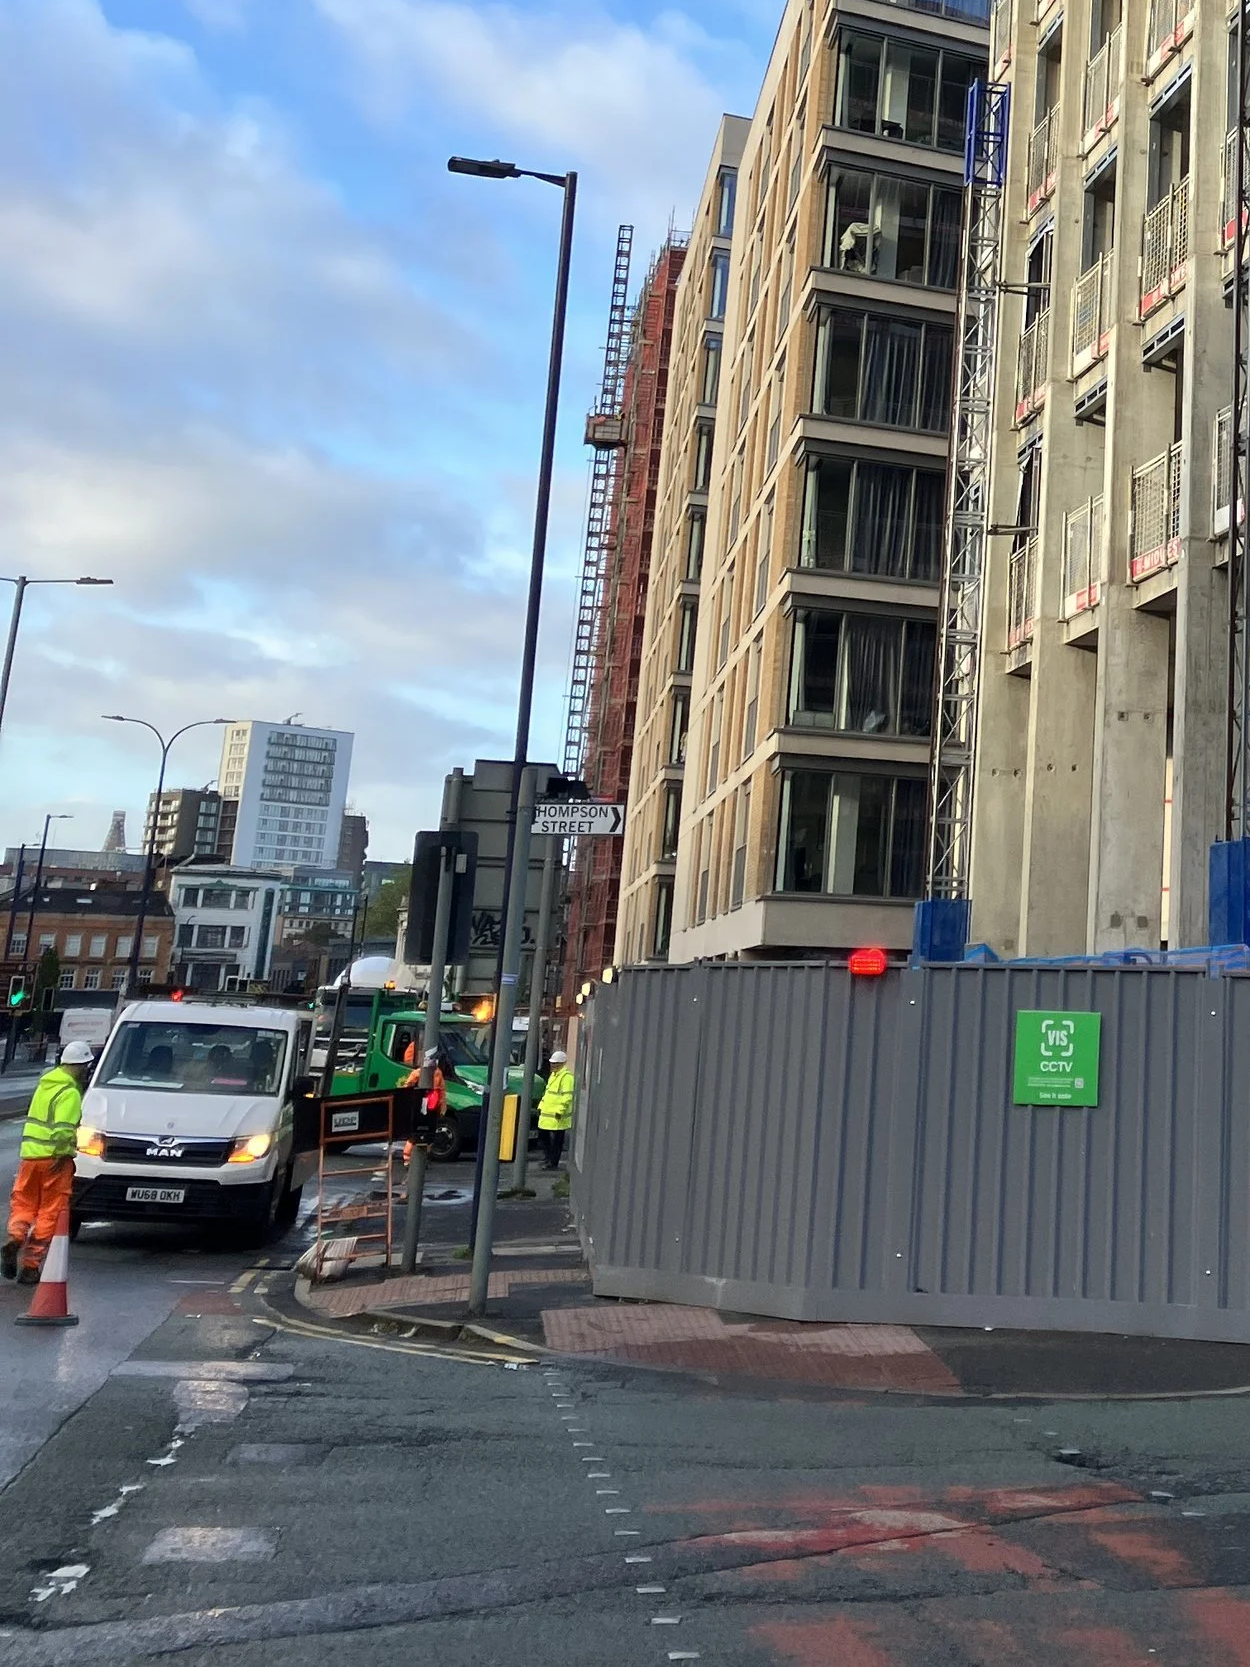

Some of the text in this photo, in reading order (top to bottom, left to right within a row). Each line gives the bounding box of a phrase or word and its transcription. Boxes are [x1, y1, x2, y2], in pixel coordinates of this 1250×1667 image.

[536, 806, 608, 818] HOMPSON
[541, 821, 594, 832] STREET
[1047, 1030, 1068, 1046] VIS
[1040, 1061, 1073, 1072] CCTV
[146, 1147, 183, 1157] MAN
